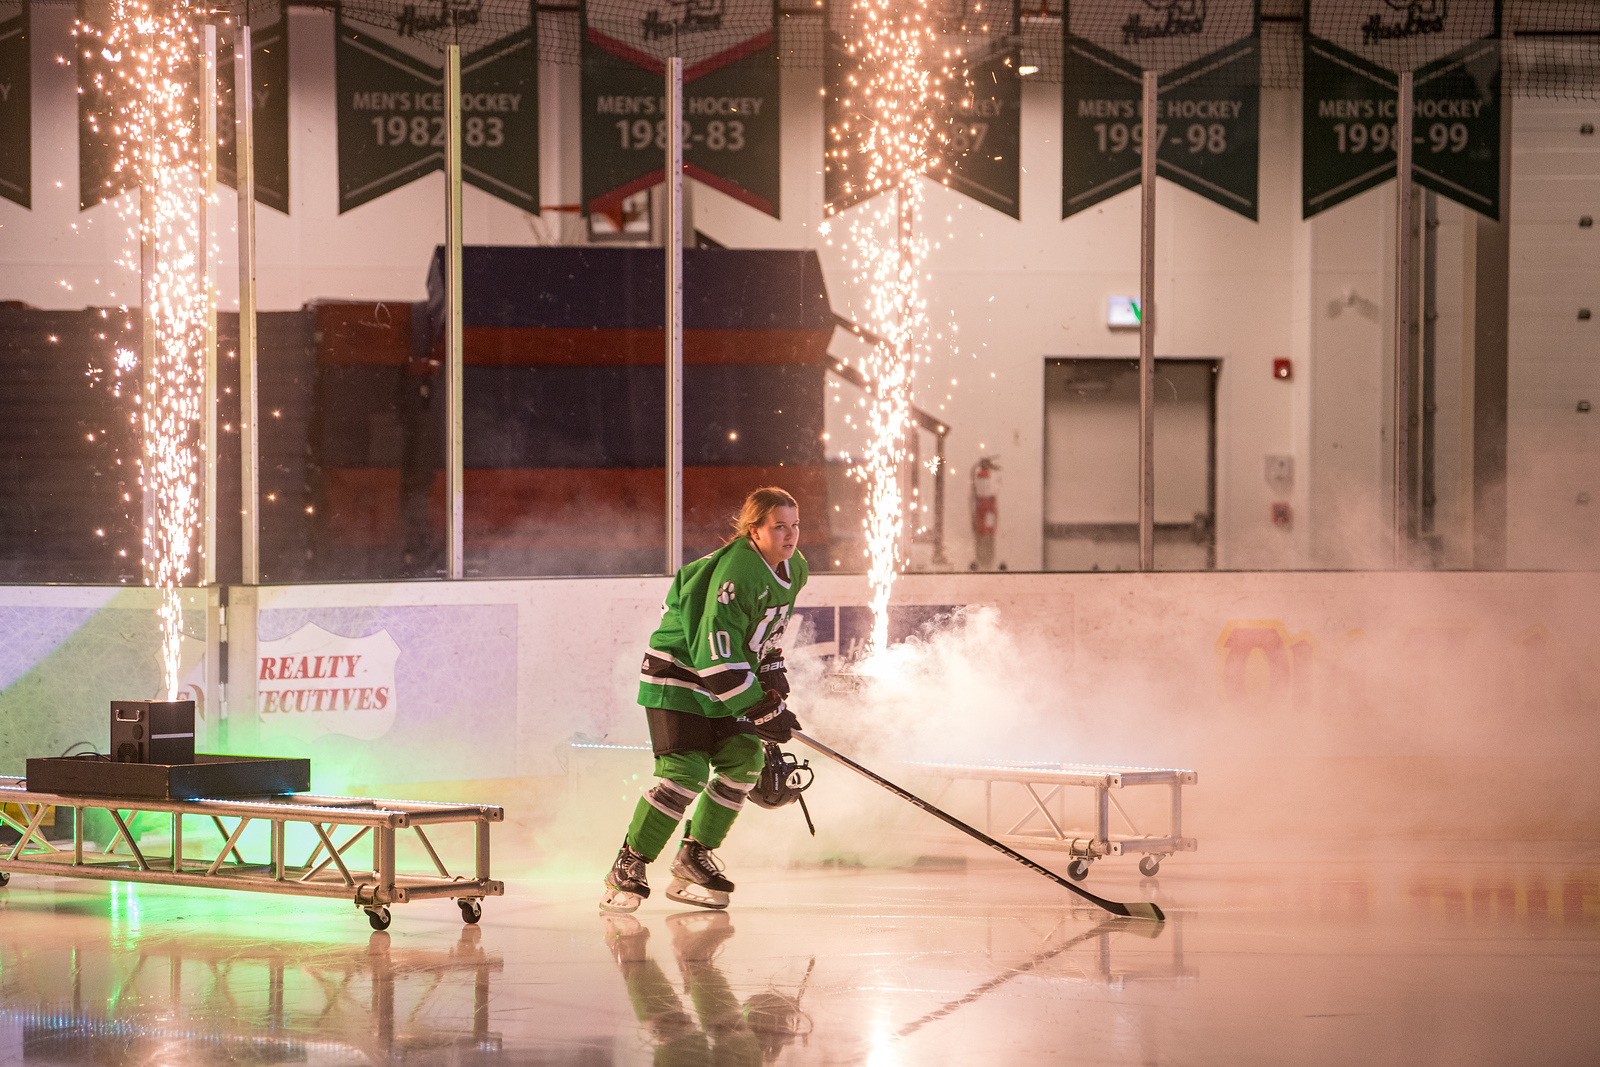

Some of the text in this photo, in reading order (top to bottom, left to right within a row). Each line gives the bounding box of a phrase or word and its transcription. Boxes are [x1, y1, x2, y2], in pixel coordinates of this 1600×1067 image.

[352, 91, 411, 111] MEN'S
[460, 92, 522, 112] OCKEY
[597, 96, 656, 115] MEN'S
[688, 97, 763, 116] HOCKEY
[1077, 100, 1243, 119] MEN'S IE HOCKEY
[1318, 100, 1375, 118] MEN'S
[1412, 100, 1482, 118] HOCKEY
[371, 115, 505, 147] 198283
[707, 630, 731, 660] 10
[259, 655, 362, 680] REALTY
